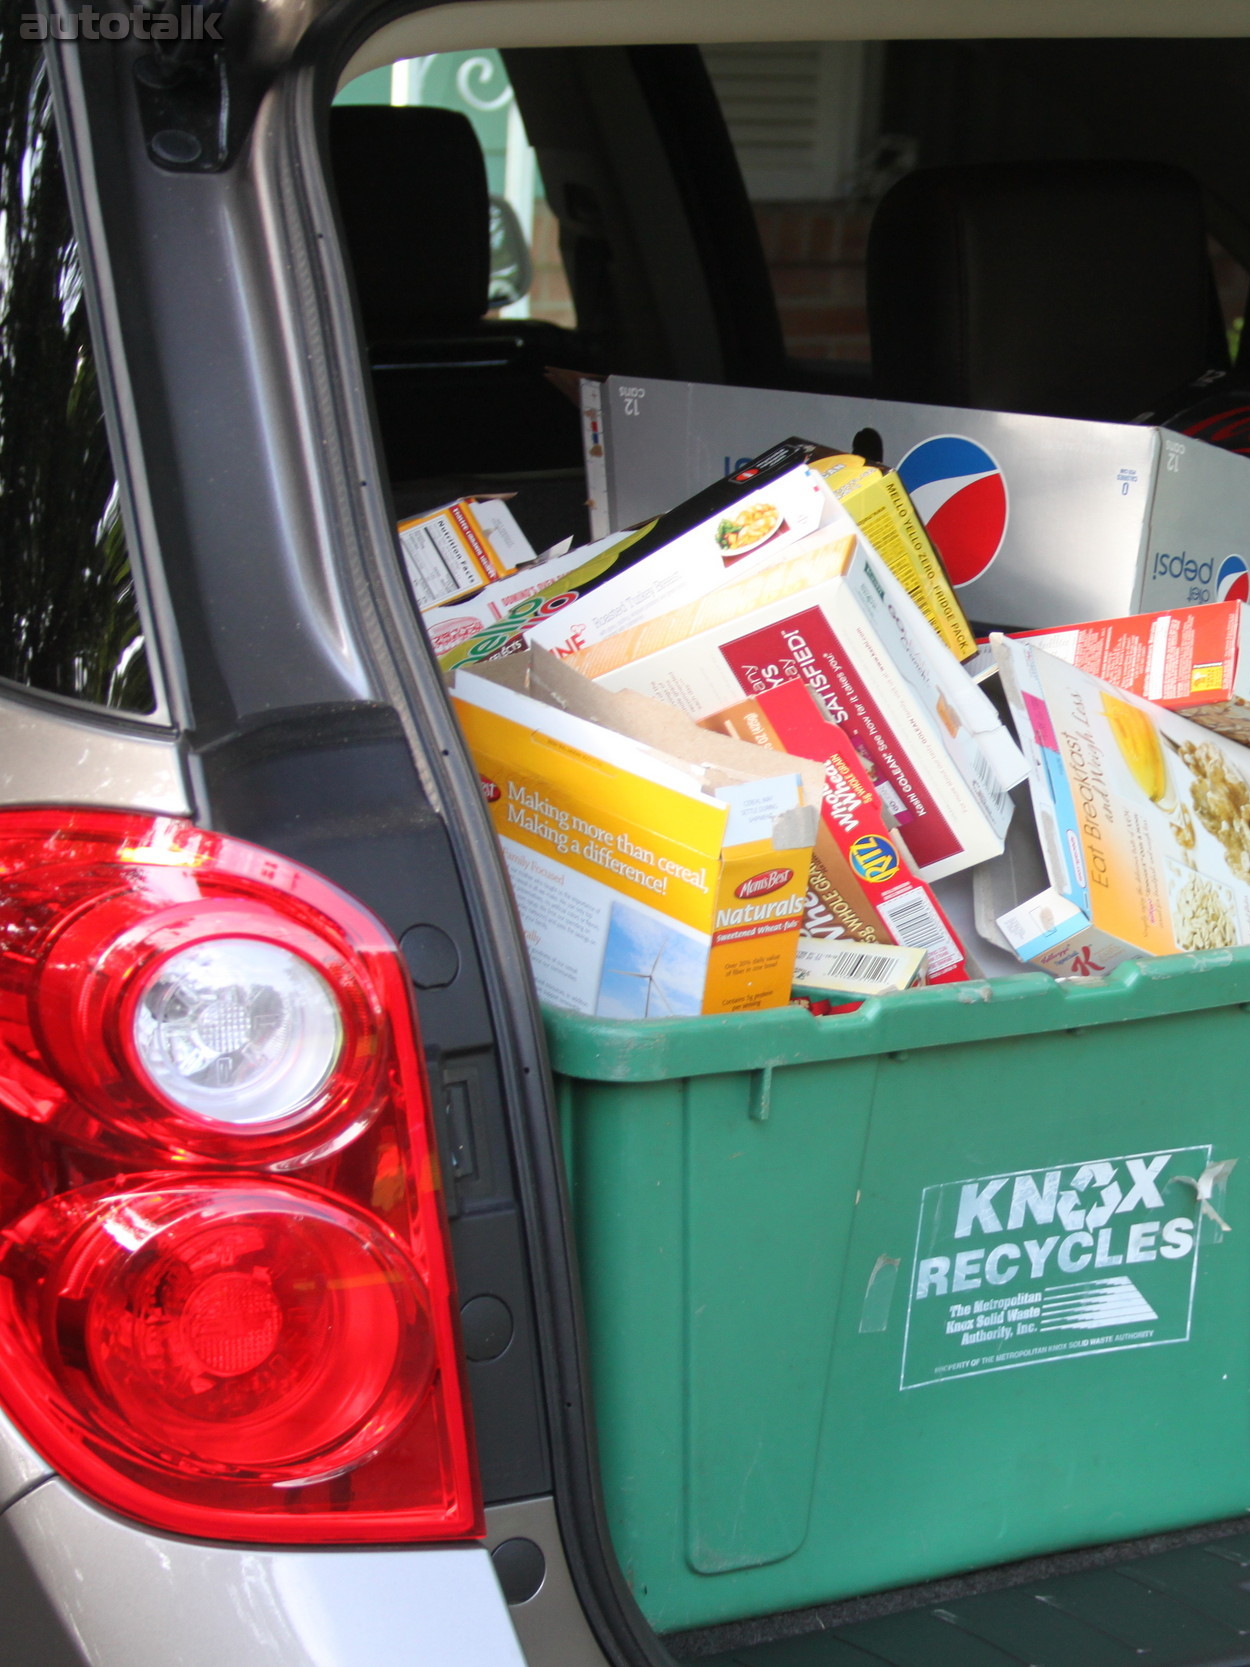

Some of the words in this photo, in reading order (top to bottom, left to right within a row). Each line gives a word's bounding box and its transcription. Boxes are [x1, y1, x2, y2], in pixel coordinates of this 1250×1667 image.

[618, 386, 646, 398] cans
[624, 399, 641, 417] 12
[1166, 452, 1180, 472] 12
[436, 519, 463, 560] Nutrition
[458, 559, 476, 584] Facts
[884, 482, 909, 518] MELLO
[901, 519, 924, 551] YELLO
[916, 552, 937, 580] ZERO
[931, 584, 957, 622] FRIDGE
[948, 622, 969, 650] PACK
[1152, 547, 1214, 586] pepsi
[834, 670, 854, 696] takes
[848, 694, 859, 704] it
[851, 701, 867, 717] far
[860, 714, 878, 736] how
[872, 733, 888, 752] See
[829, 750, 850, 776] GRAIN
[1075, 727, 1108, 789] Weigh
[845, 771, 866, 797] WHOLE
[1061, 728, 1102, 842] Breakfast
[906, 791, 927, 817] Kashi
[1094, 787, 1114, 824] and
[498, 803, 577, 855] Making
[569, 839, 583, 854] a
[579, 839, 674, 896] difference!
[500, 780, 573, 829] Making
[567, 815, 617, 847] more
[612, 831, 660, 866] than
[653, 851, 716, 894] cereal,
[848, 830, 901, 886] RITZ
[1087, 843, 1109, 889] Eat
[736, 876, 769, 898] Mom's
[765, 868, 794, 888] Best
[714, 892, 805, 929] Naturals
[822, 889, 864, 931] WHOLE
[715, 927, 757, 943] Sweetened
[1063, 941, 1105, 983] K
[915, 1217, 1195, 1300] RECYCLES
[950, 1304, 971, 1318] The
[973, 1292, 1042, 1315] Metropolitan
[945, 1319, 975, 1334] Knox
[976, 1313, 1004, 1329] Solid
[1006, 1307, 1041, 1323] Waste
[961, 1327, 1013, 1346] Authority,
[1016, 1322, 1038, 1336] Inc.
[971, 1357, 981, 1367] OF
[981, 1355, 995, 1365] THE
[995, 1346, 1048, 1363] METROPOLITAN
[1048, 1343, 1068, 1353] KNOX
[1068, 1339, 1089, 1350] SOLID
[1089, 1335, 1114, 1346] WASTE
[1114, 1330, 1155, 1342] AUTHORITY
